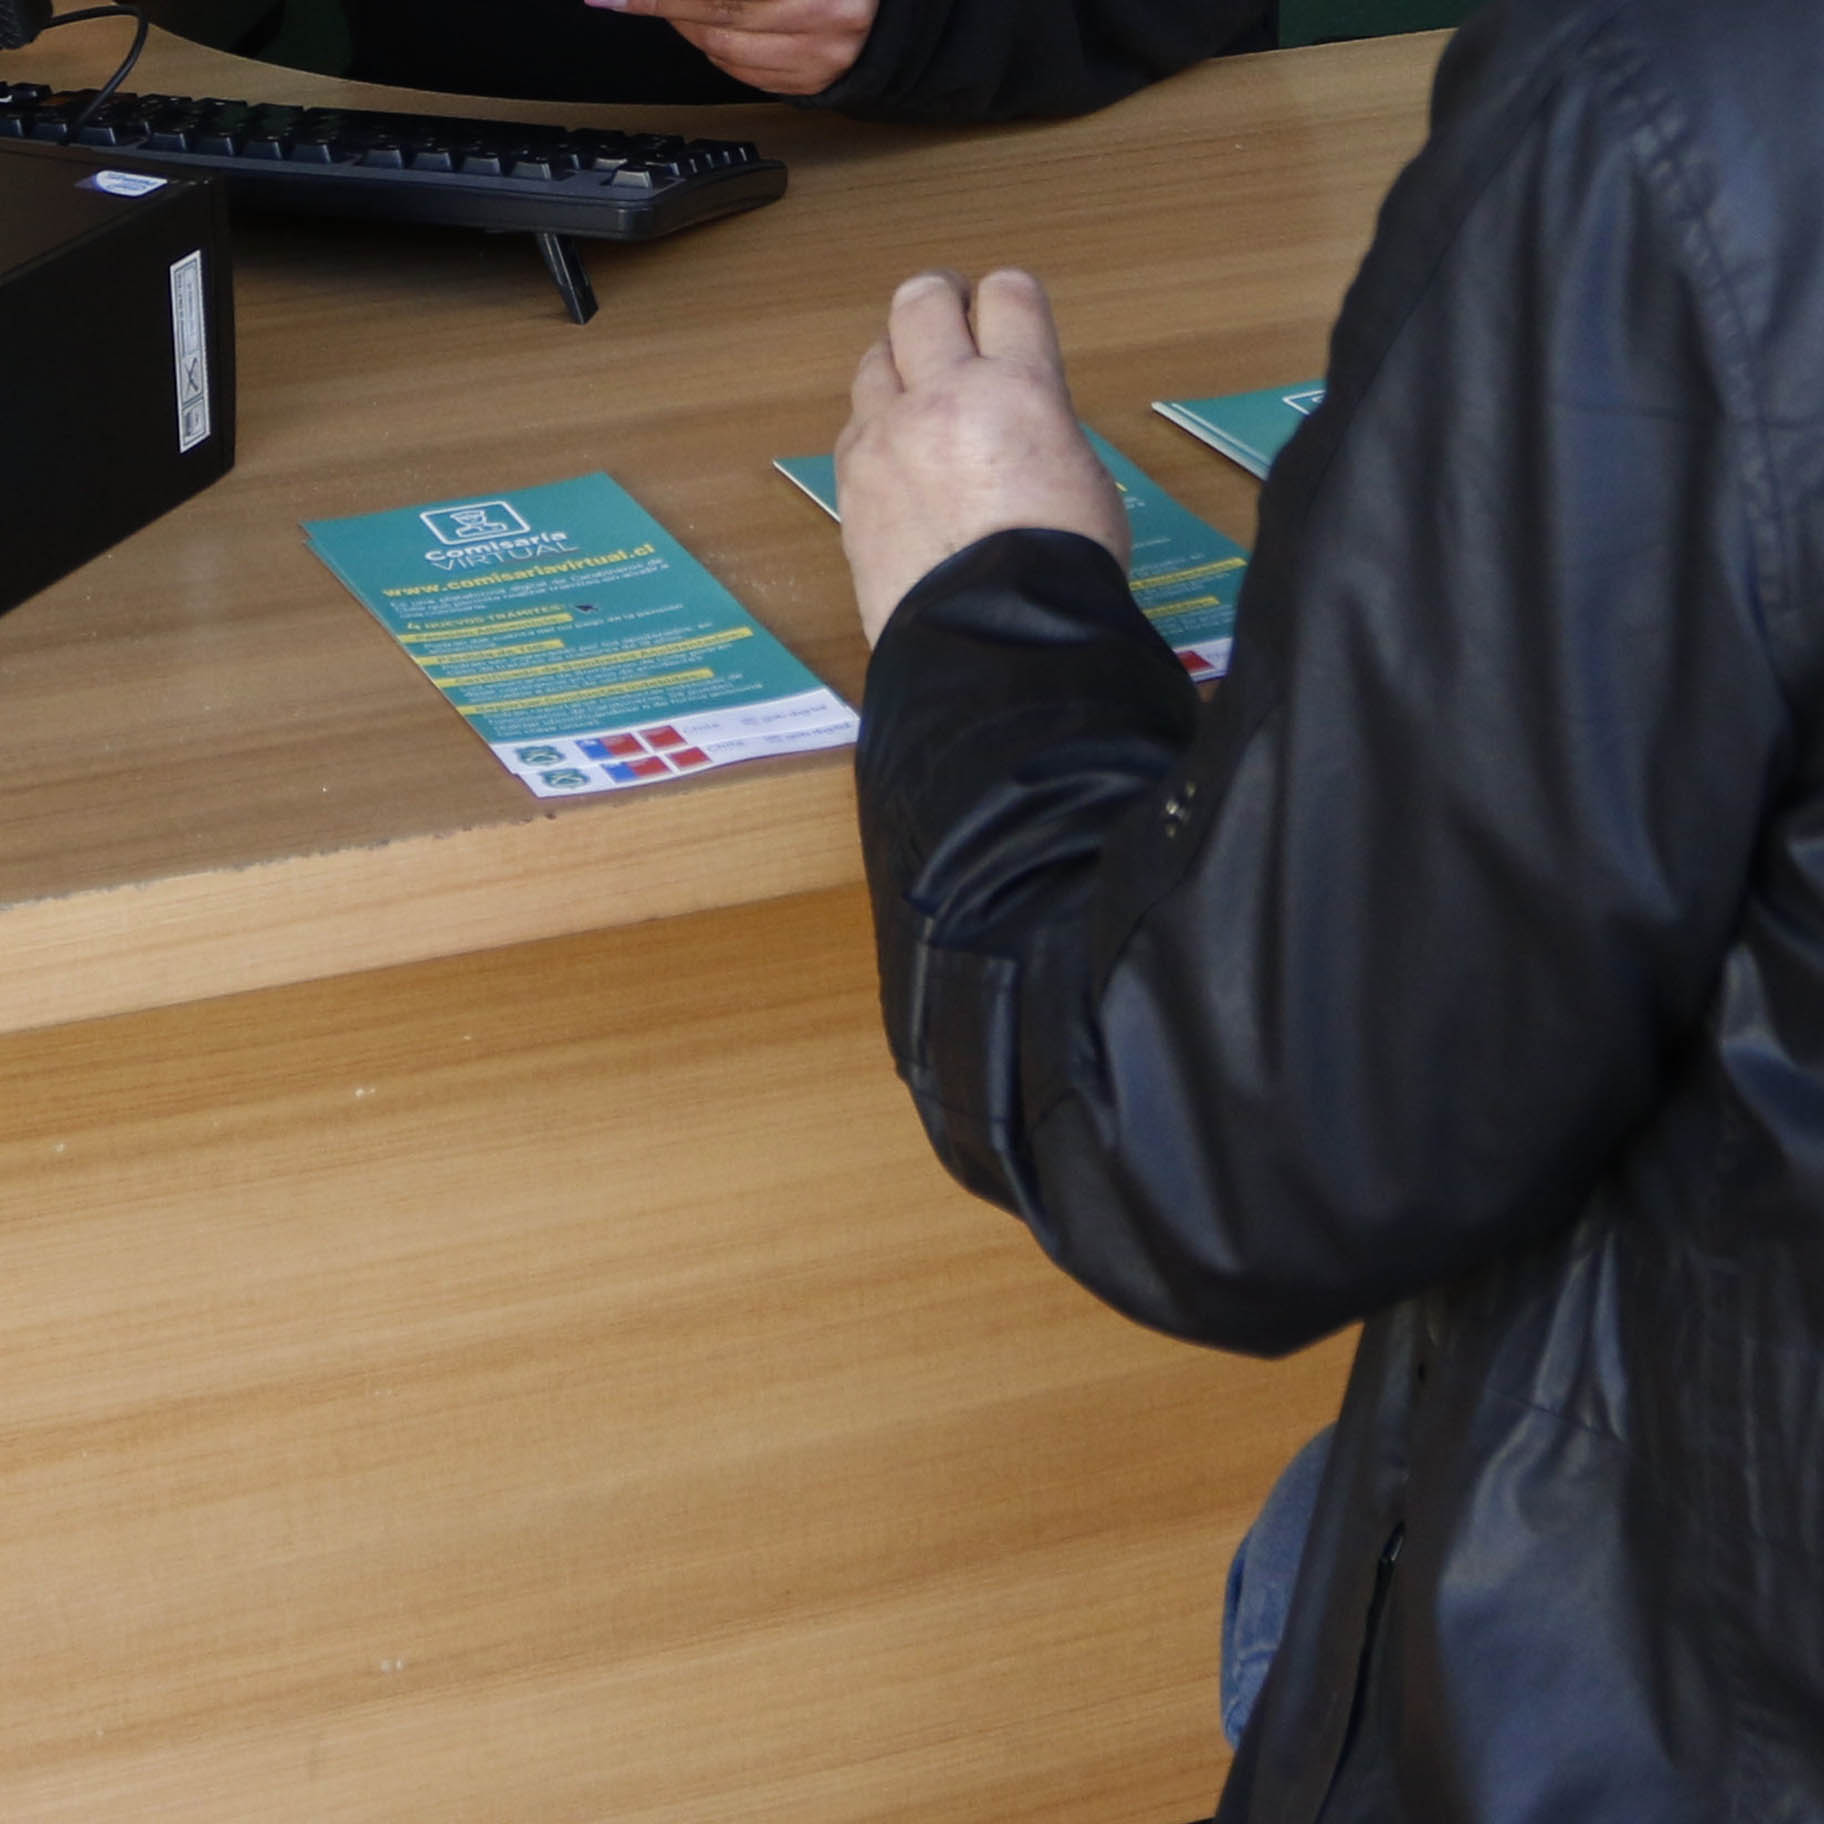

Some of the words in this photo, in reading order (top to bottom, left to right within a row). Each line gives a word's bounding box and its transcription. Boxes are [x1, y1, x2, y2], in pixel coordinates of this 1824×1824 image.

[381, 542, 657, 598] www.comisariavirtual.cl
[430, 541, 580, 572] VIRTUAL
[407, 621, 422, 631] 4
